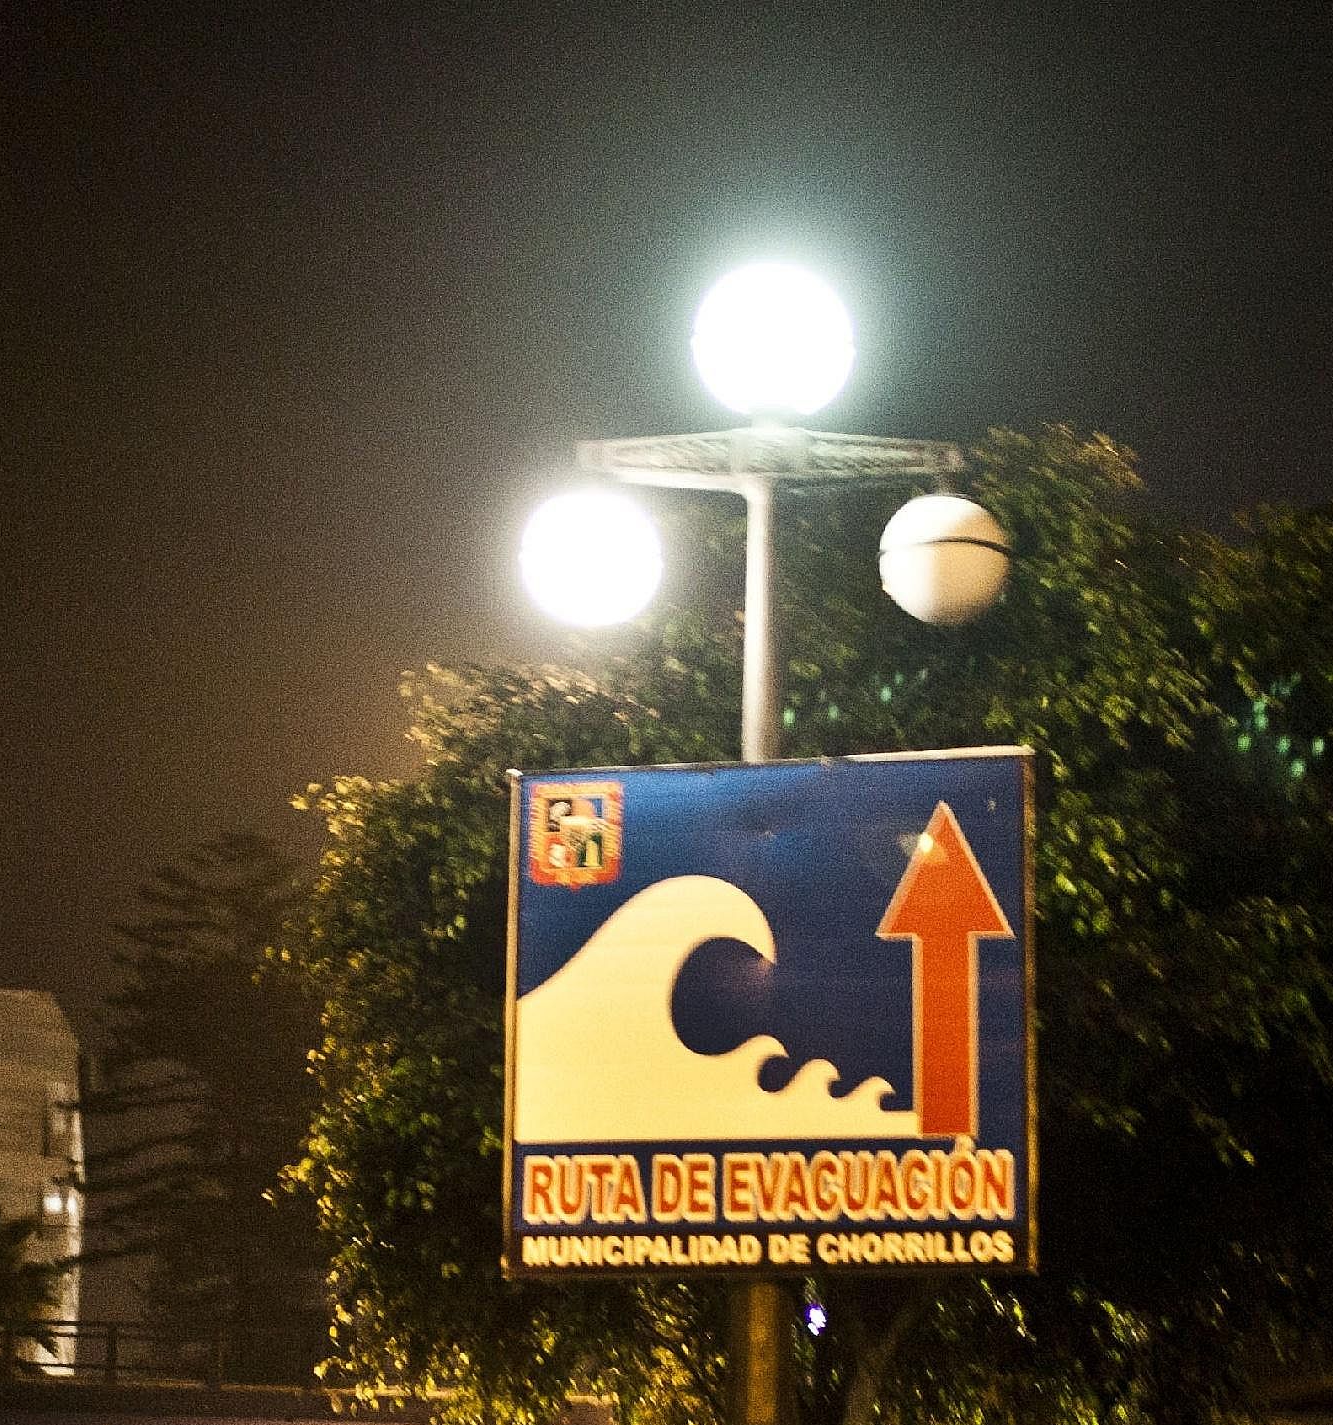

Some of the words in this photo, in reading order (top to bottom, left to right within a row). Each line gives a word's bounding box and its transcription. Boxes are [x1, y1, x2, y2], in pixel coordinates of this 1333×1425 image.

[523, 1154, 647, 1224] RUTA
[651, 1154, 716, 1223] DE
[723, 1135, 1015, 1222] EVACUACIÓN
[522, 1234, 763, 1266] MUNICIPALIDAD
[767, 1233, 811, 1264] DE
[818, 1230, 1014, 1264] CHORRILLOS
